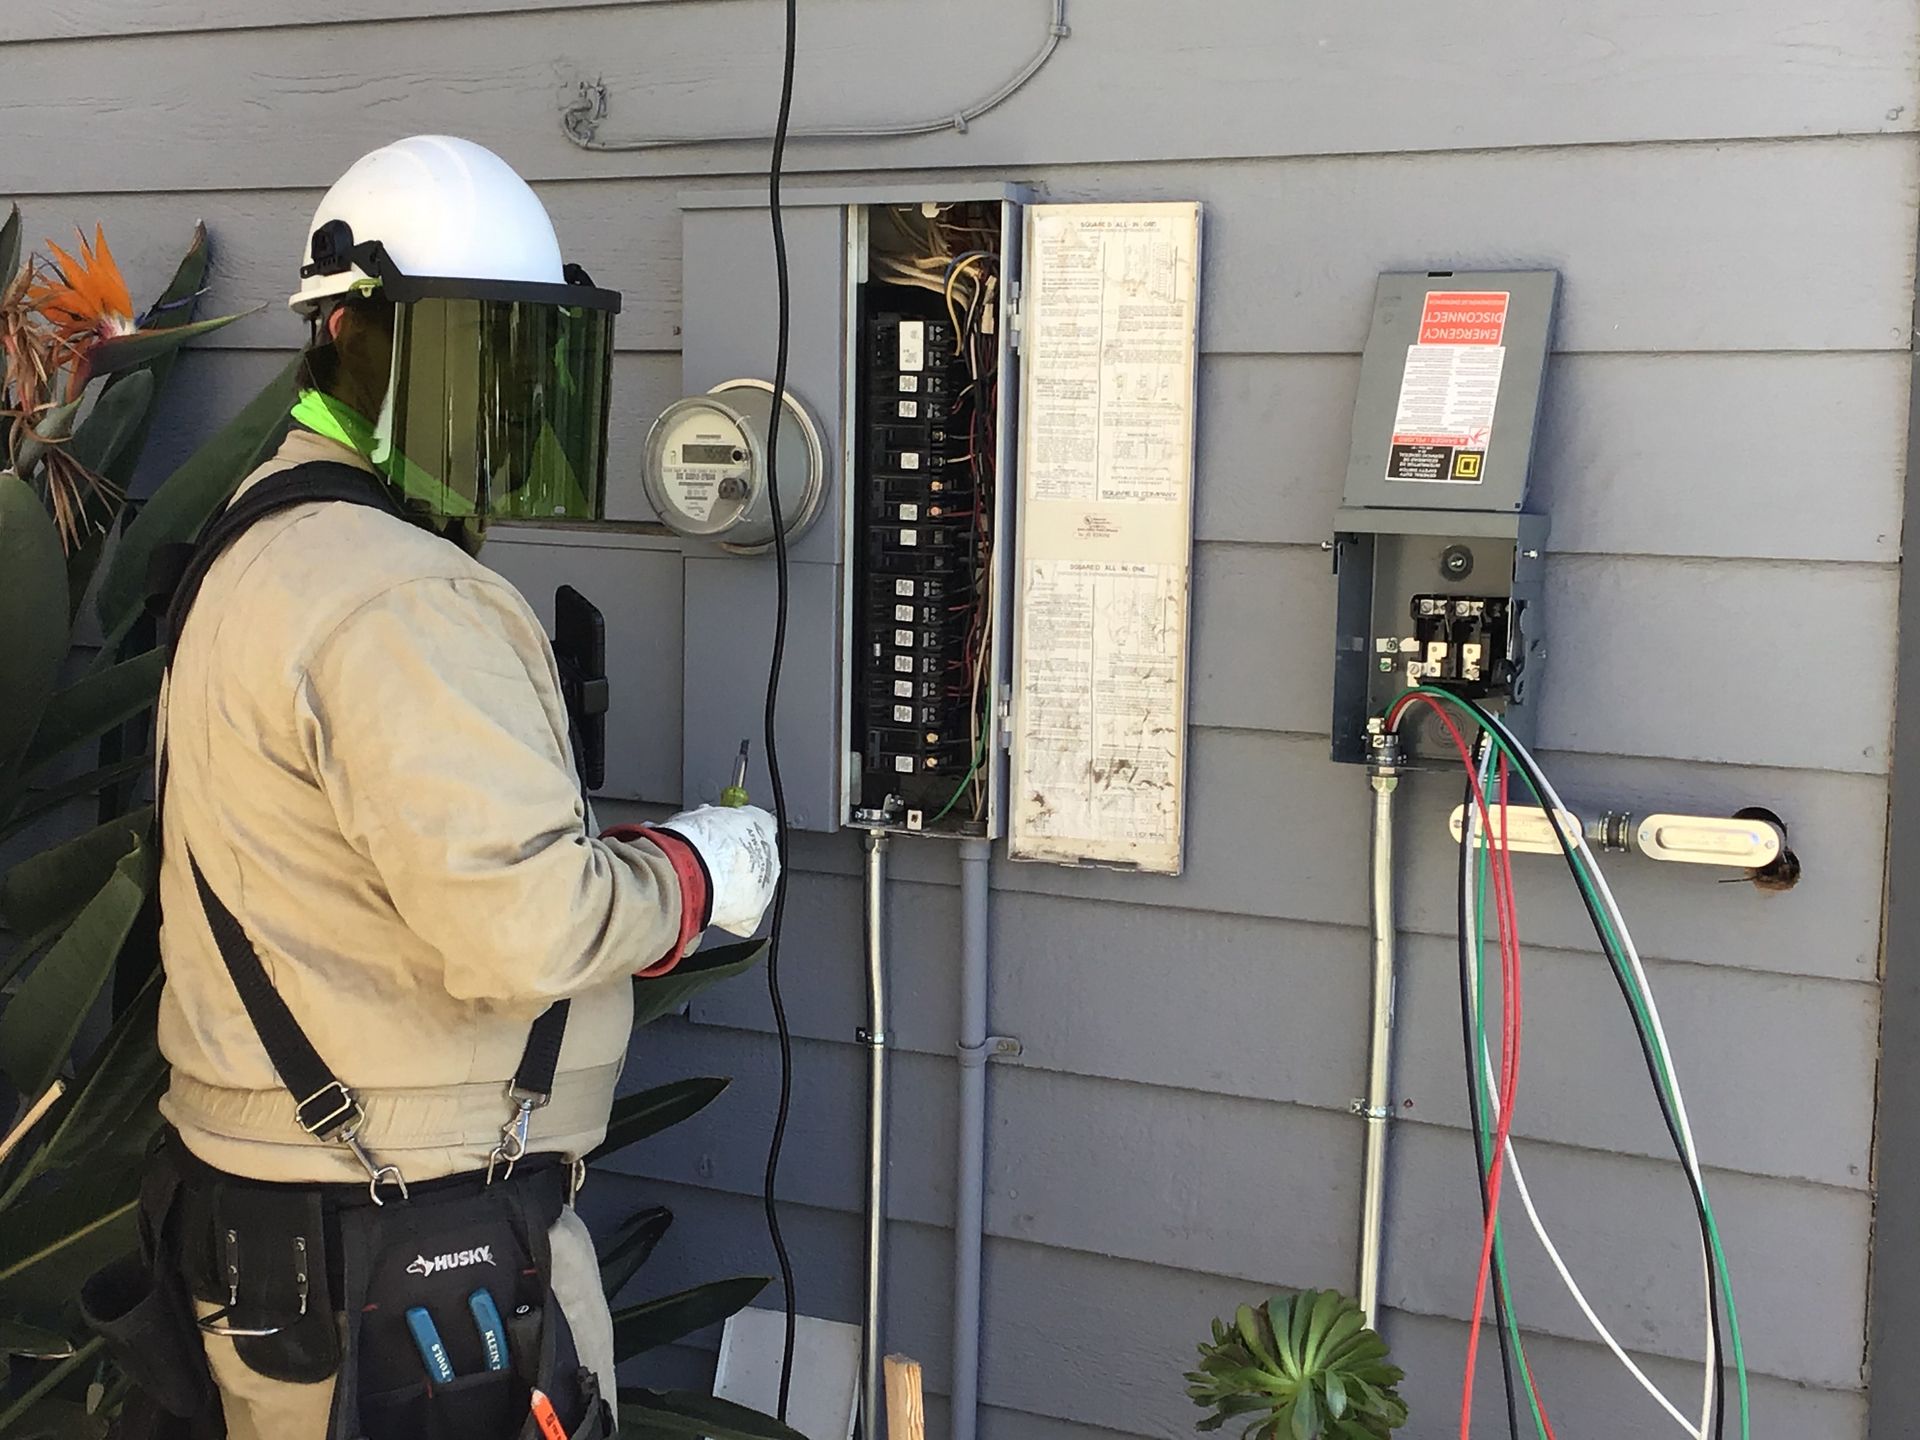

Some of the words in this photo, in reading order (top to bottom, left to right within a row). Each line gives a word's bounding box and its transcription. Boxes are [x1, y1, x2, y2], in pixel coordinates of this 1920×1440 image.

[1425, 311, 1504, 323] DISCONNECT
[1424, 328, 1499, 340] EMERGENCY
[434, 1245, 492, 1272] HUSKY
[431, 1343, 451, 1378] TOOLS
[485, 1330, 501, 1366] KLEIN
